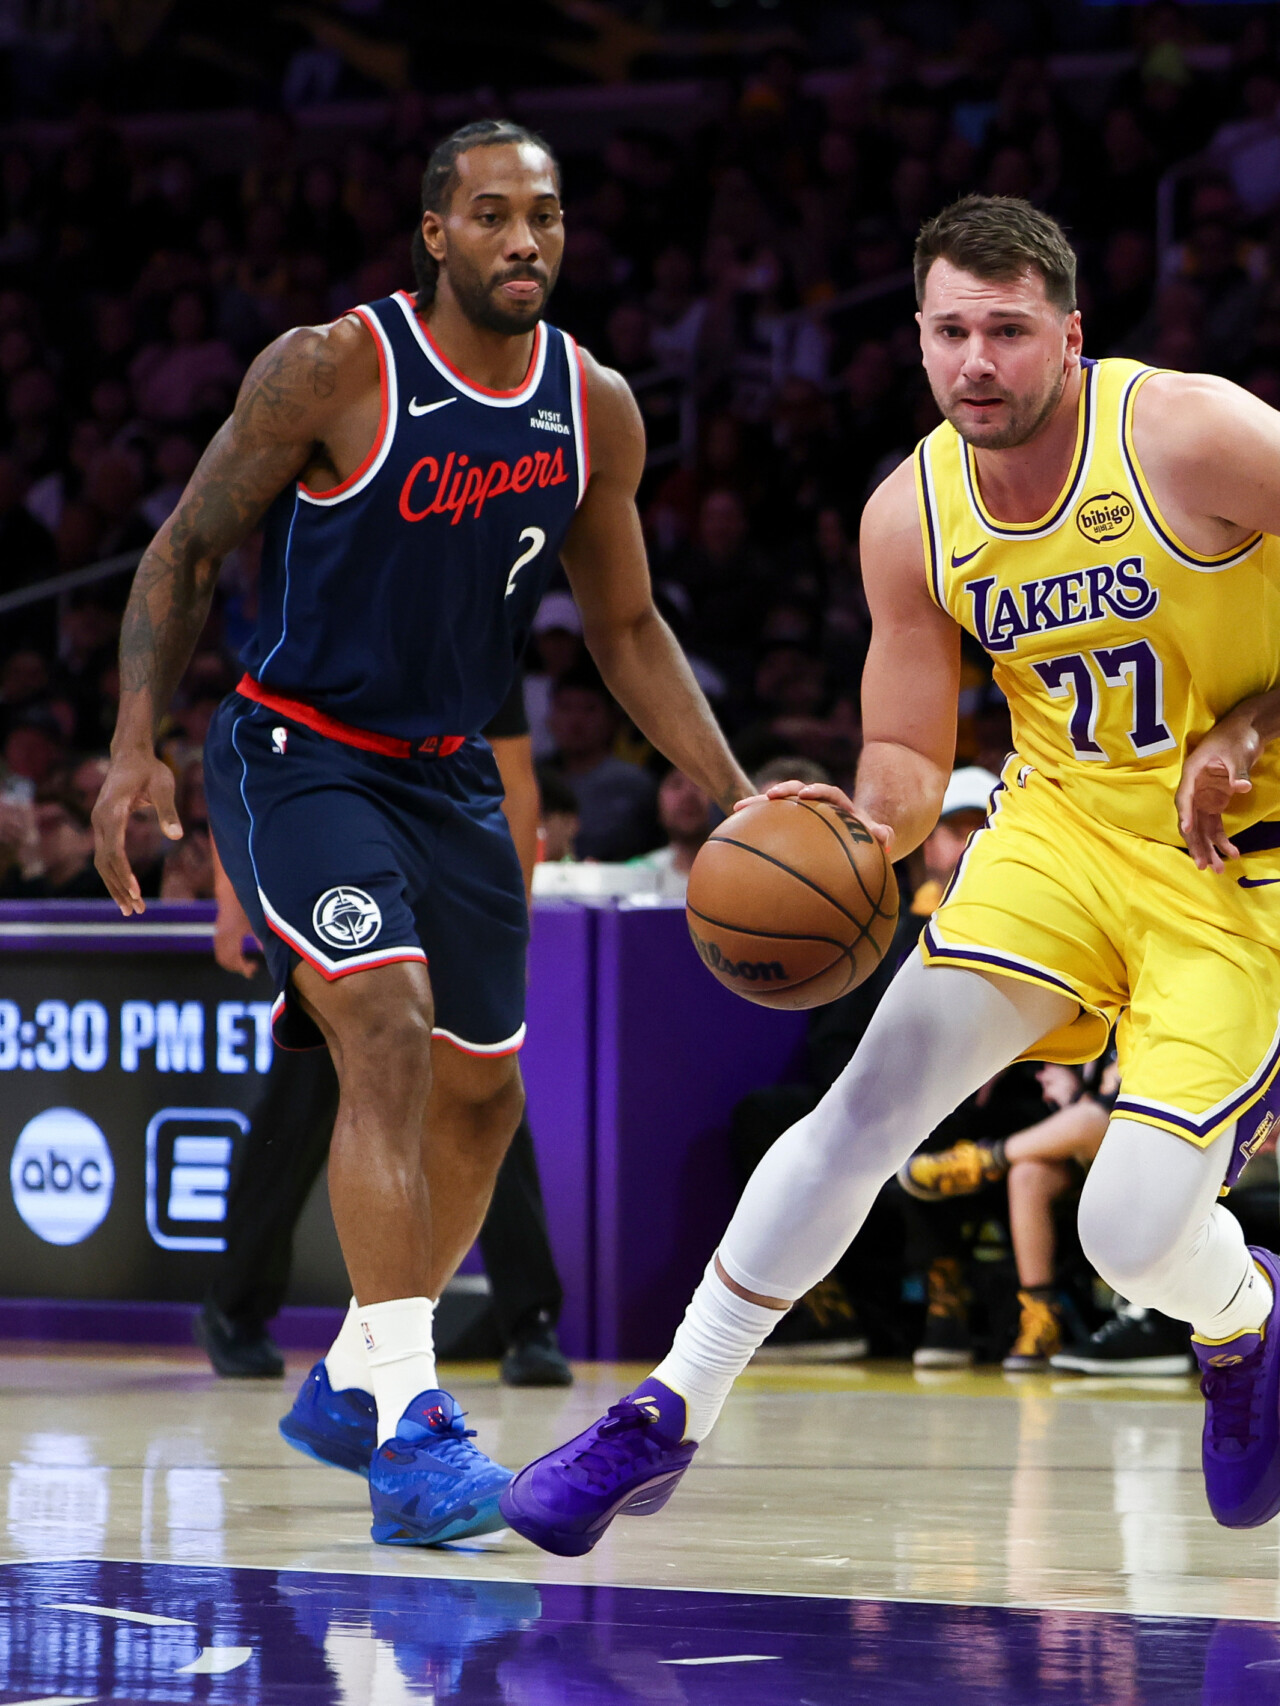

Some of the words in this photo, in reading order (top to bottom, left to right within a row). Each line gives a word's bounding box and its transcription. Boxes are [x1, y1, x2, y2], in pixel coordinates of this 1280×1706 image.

[530, 417, 570, 435] RWANDA
[538, 409, 561, 423] VISIT
[398, 447, 569, 526] Clippers
[1081, 505, 1130, 528] bibigo
[503, 526, 546, 600] 2
[964, 556, 1160, 653] LAKERS
[1029, 637, 1177, 762] 77
[120, 1000, 206, 1073] PM
[216, 1001, 275, 1074] ET
[22, 1147, 103, 1193] abc
